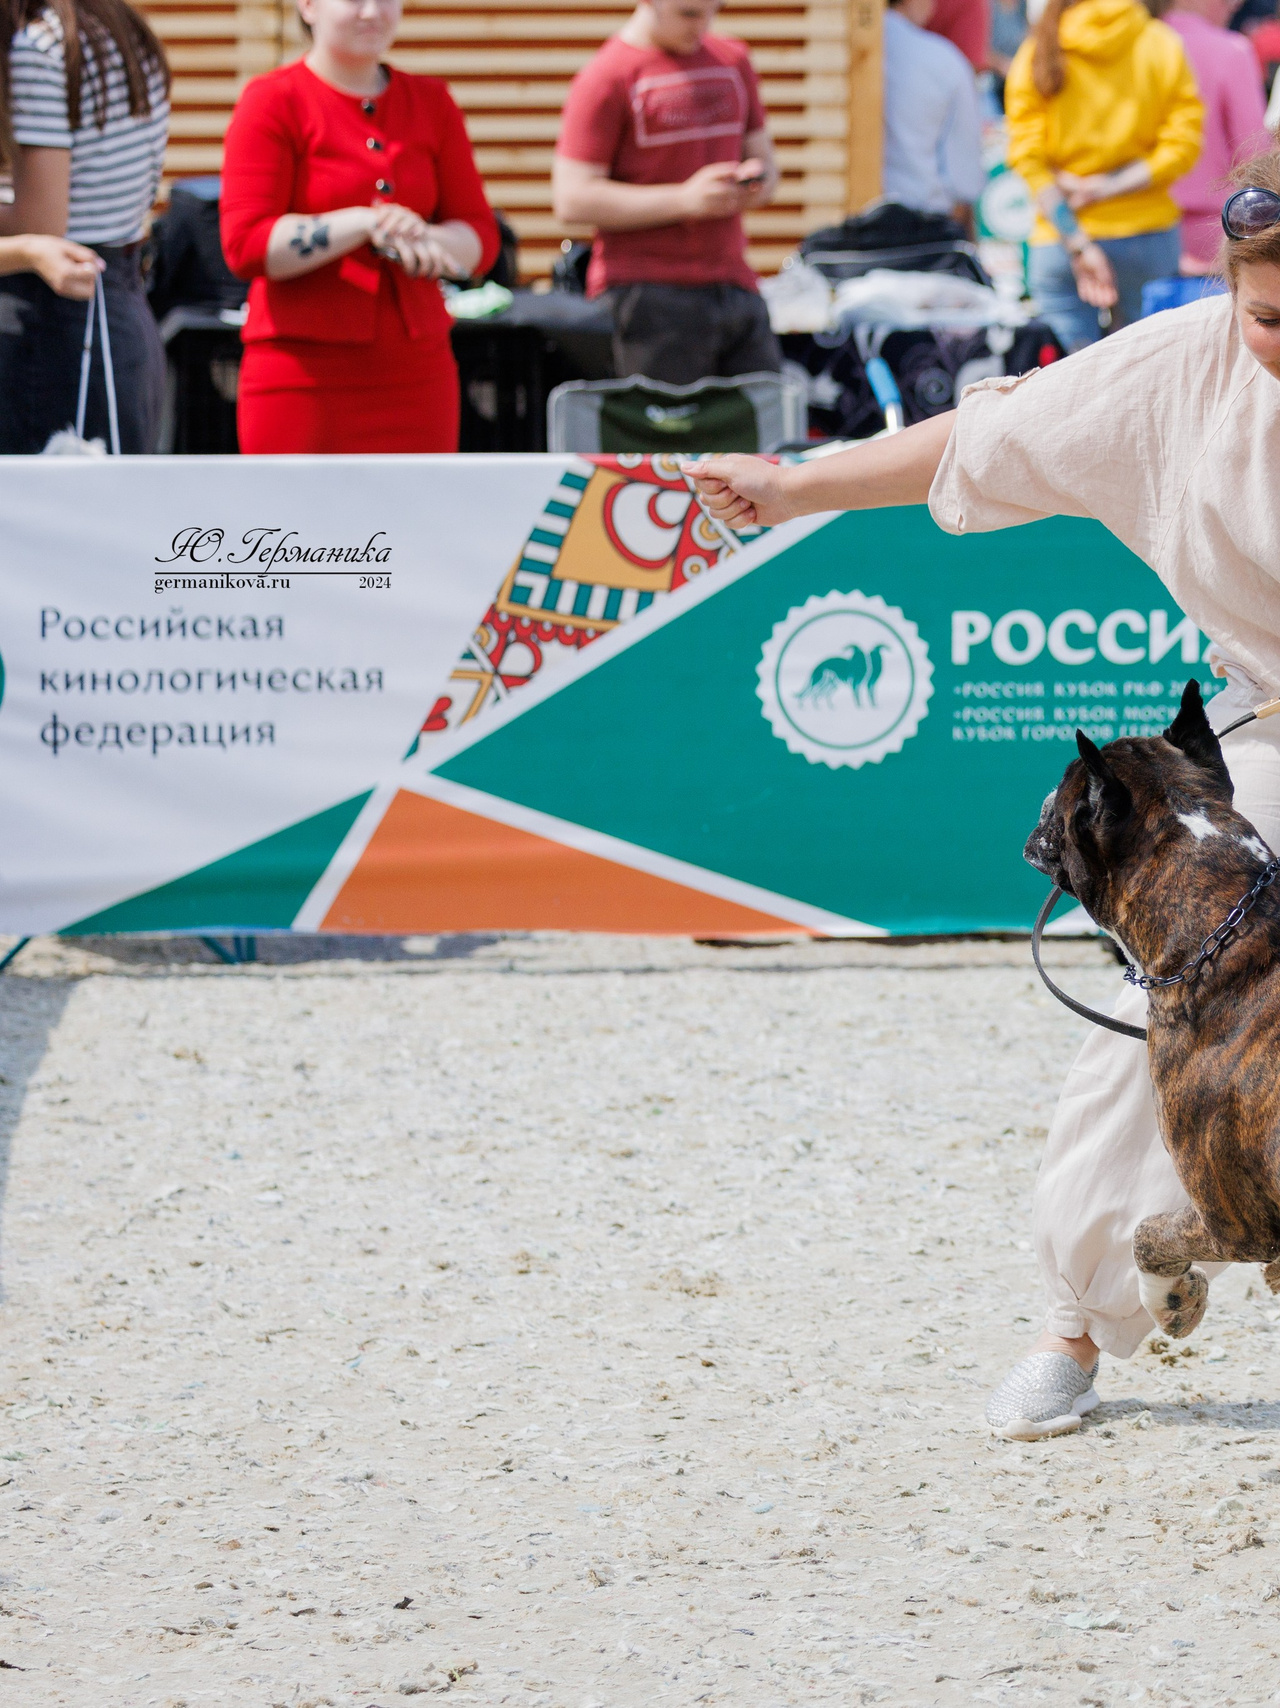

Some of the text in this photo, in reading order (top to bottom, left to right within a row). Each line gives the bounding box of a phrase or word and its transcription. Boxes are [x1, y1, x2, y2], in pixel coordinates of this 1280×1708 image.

[40, 606, 285, 641] Российская
[40, 667, 385, 693] кинологическая
[40, 711, 277, 757] федерация
